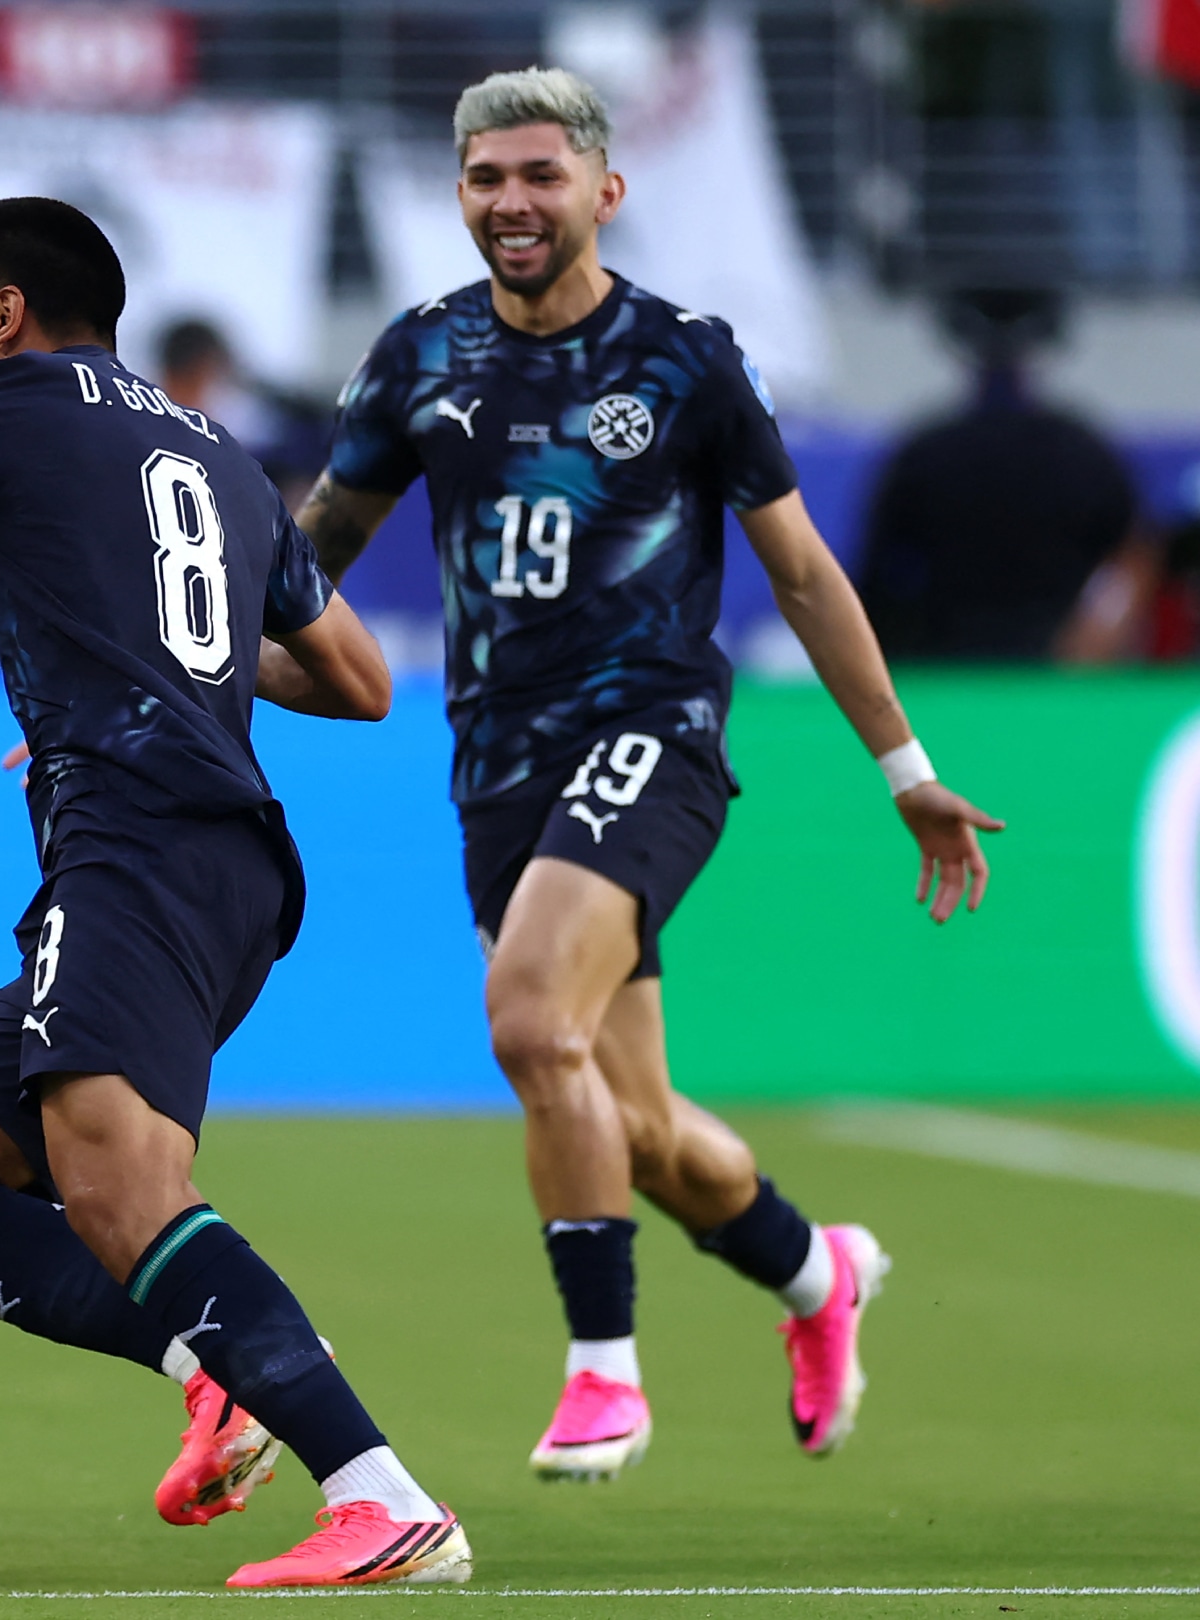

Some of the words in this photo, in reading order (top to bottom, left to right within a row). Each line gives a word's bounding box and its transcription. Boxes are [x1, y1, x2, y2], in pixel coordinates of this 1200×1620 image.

[71, 362, 113, 406] D.
[140, 448, 236, 686] 8
[490, 495, 573, 599] 19
[561, 731, 663, 806] 19
[32, 904, 65, 1008] 8
